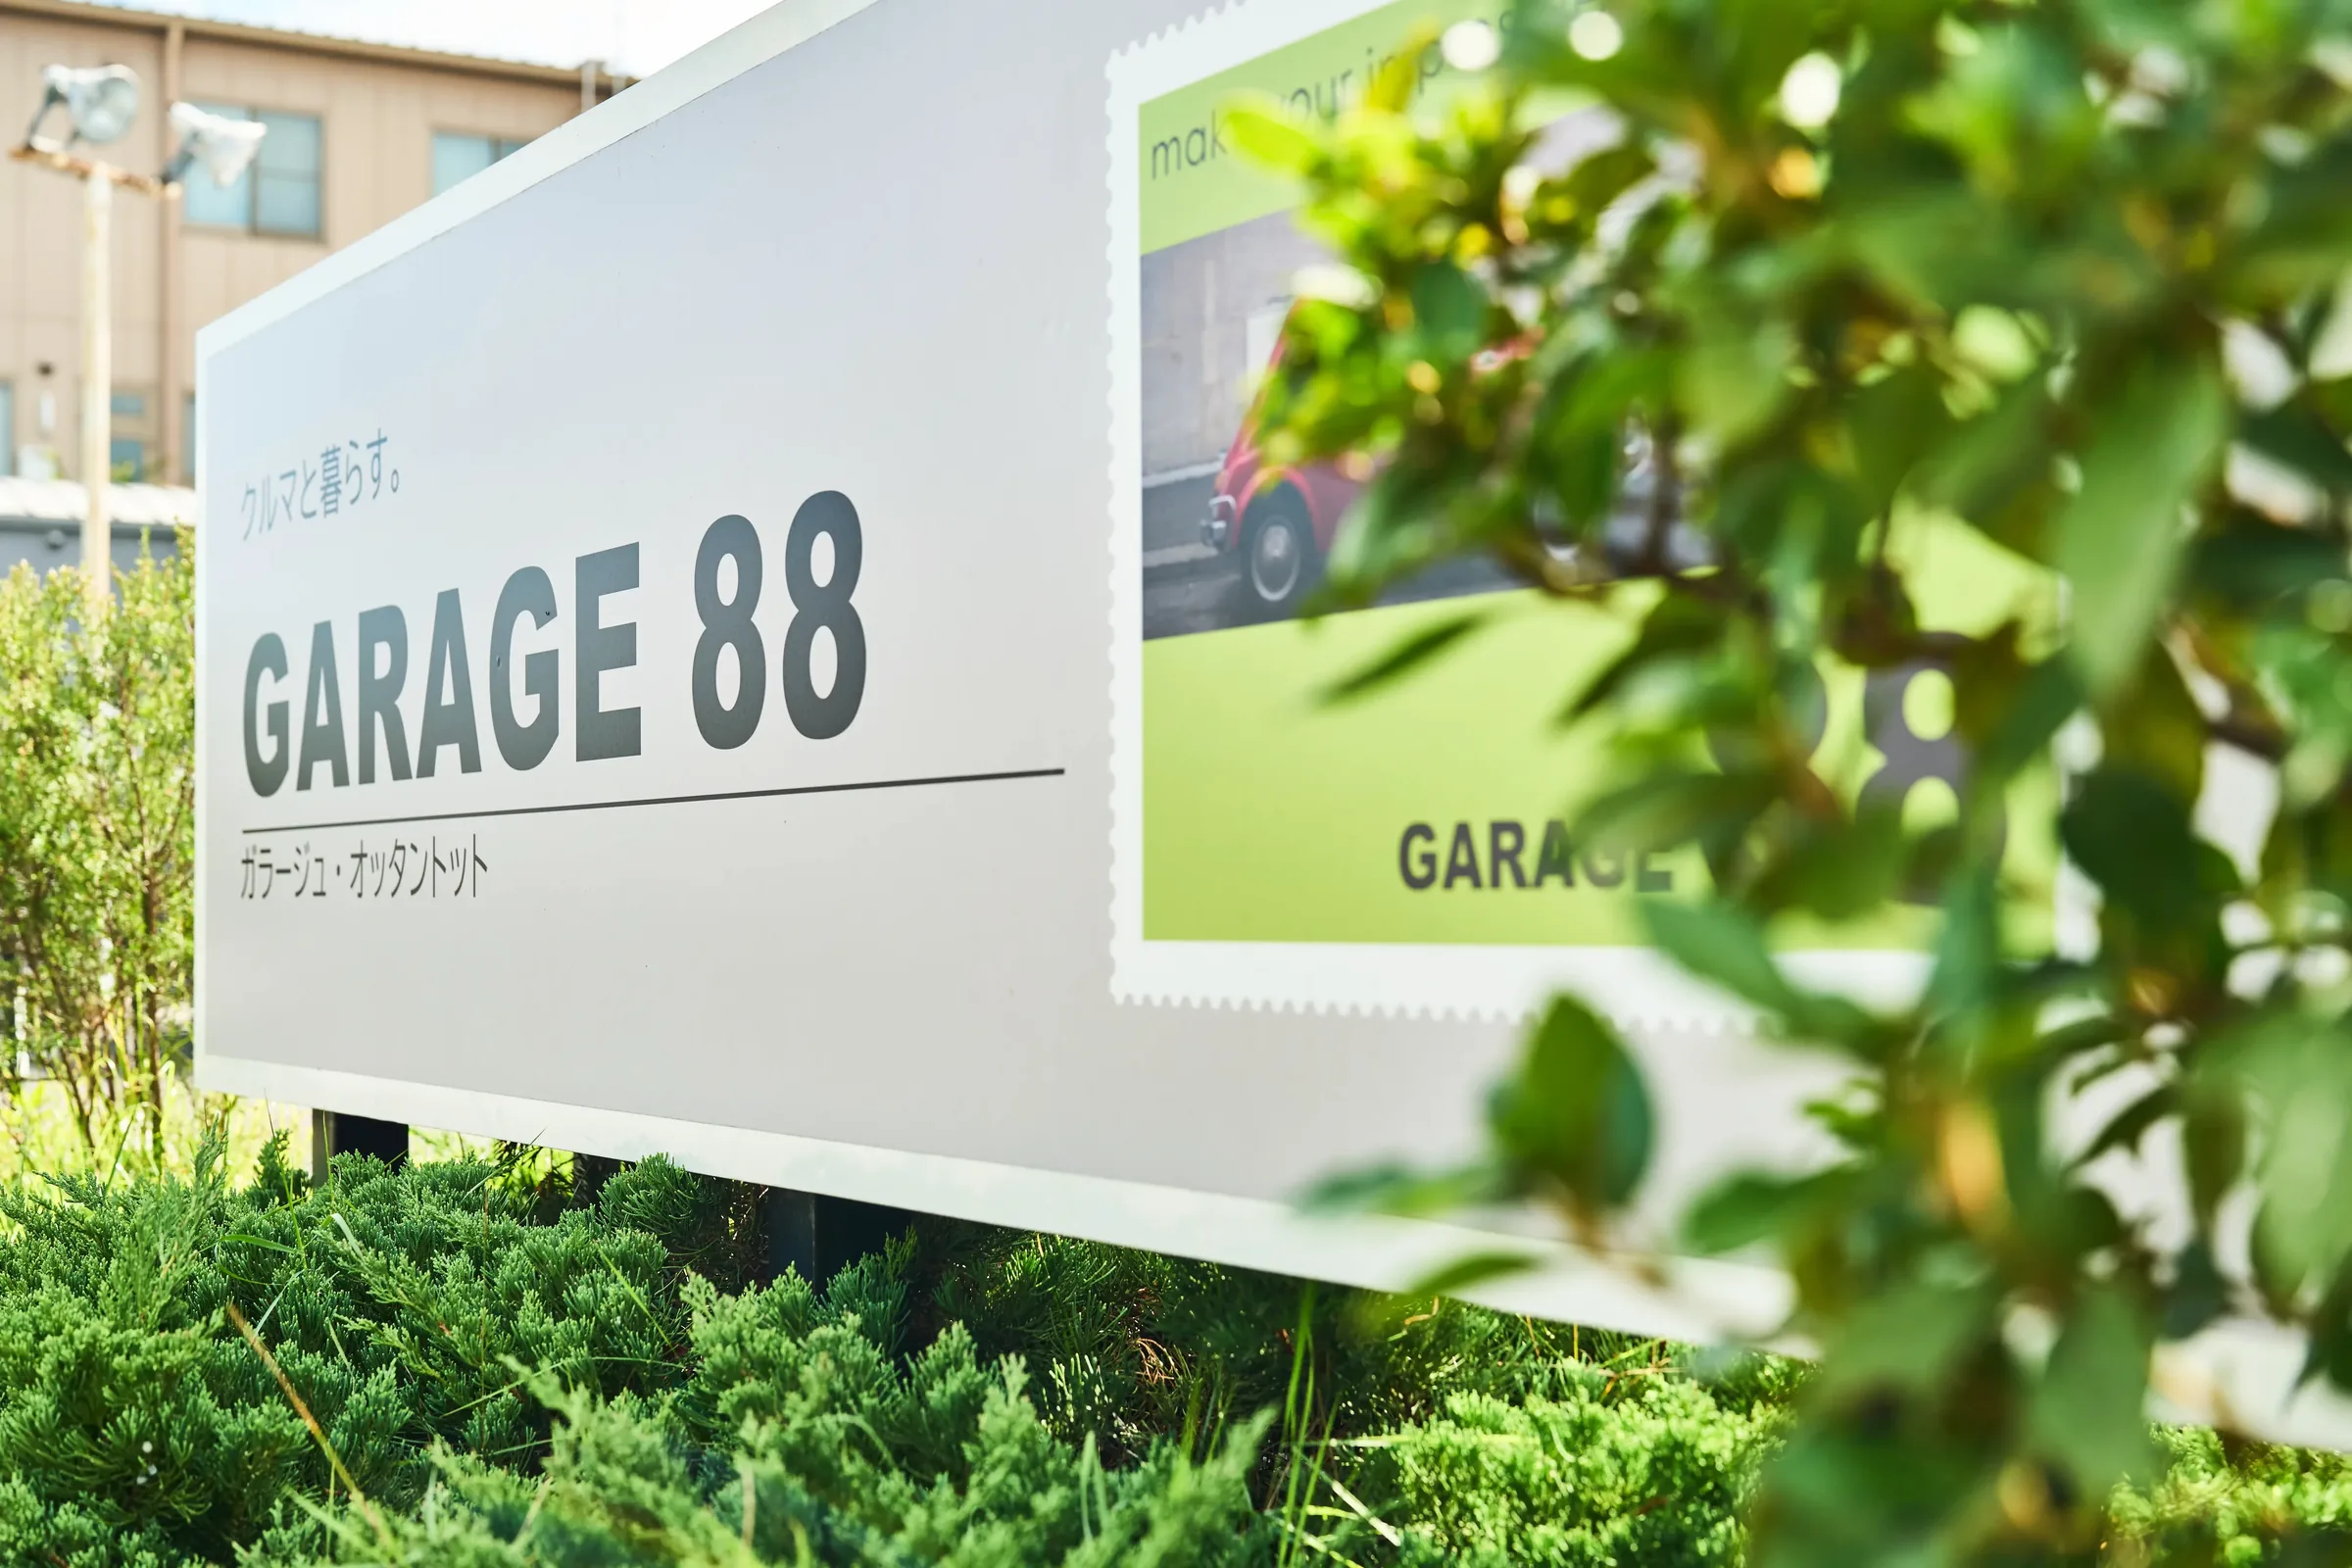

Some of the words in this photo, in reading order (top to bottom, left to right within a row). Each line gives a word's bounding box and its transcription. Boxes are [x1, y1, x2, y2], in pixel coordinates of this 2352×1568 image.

[1152, 108, 1237, 180] mak
[241, 427, 399, 542] クルマと暮らす。
[243, 541, 642, 798] GARAGE
[691, 490, 866, 751] 88
[241, 833, 488, 899] ガラージュ・オッタントット
